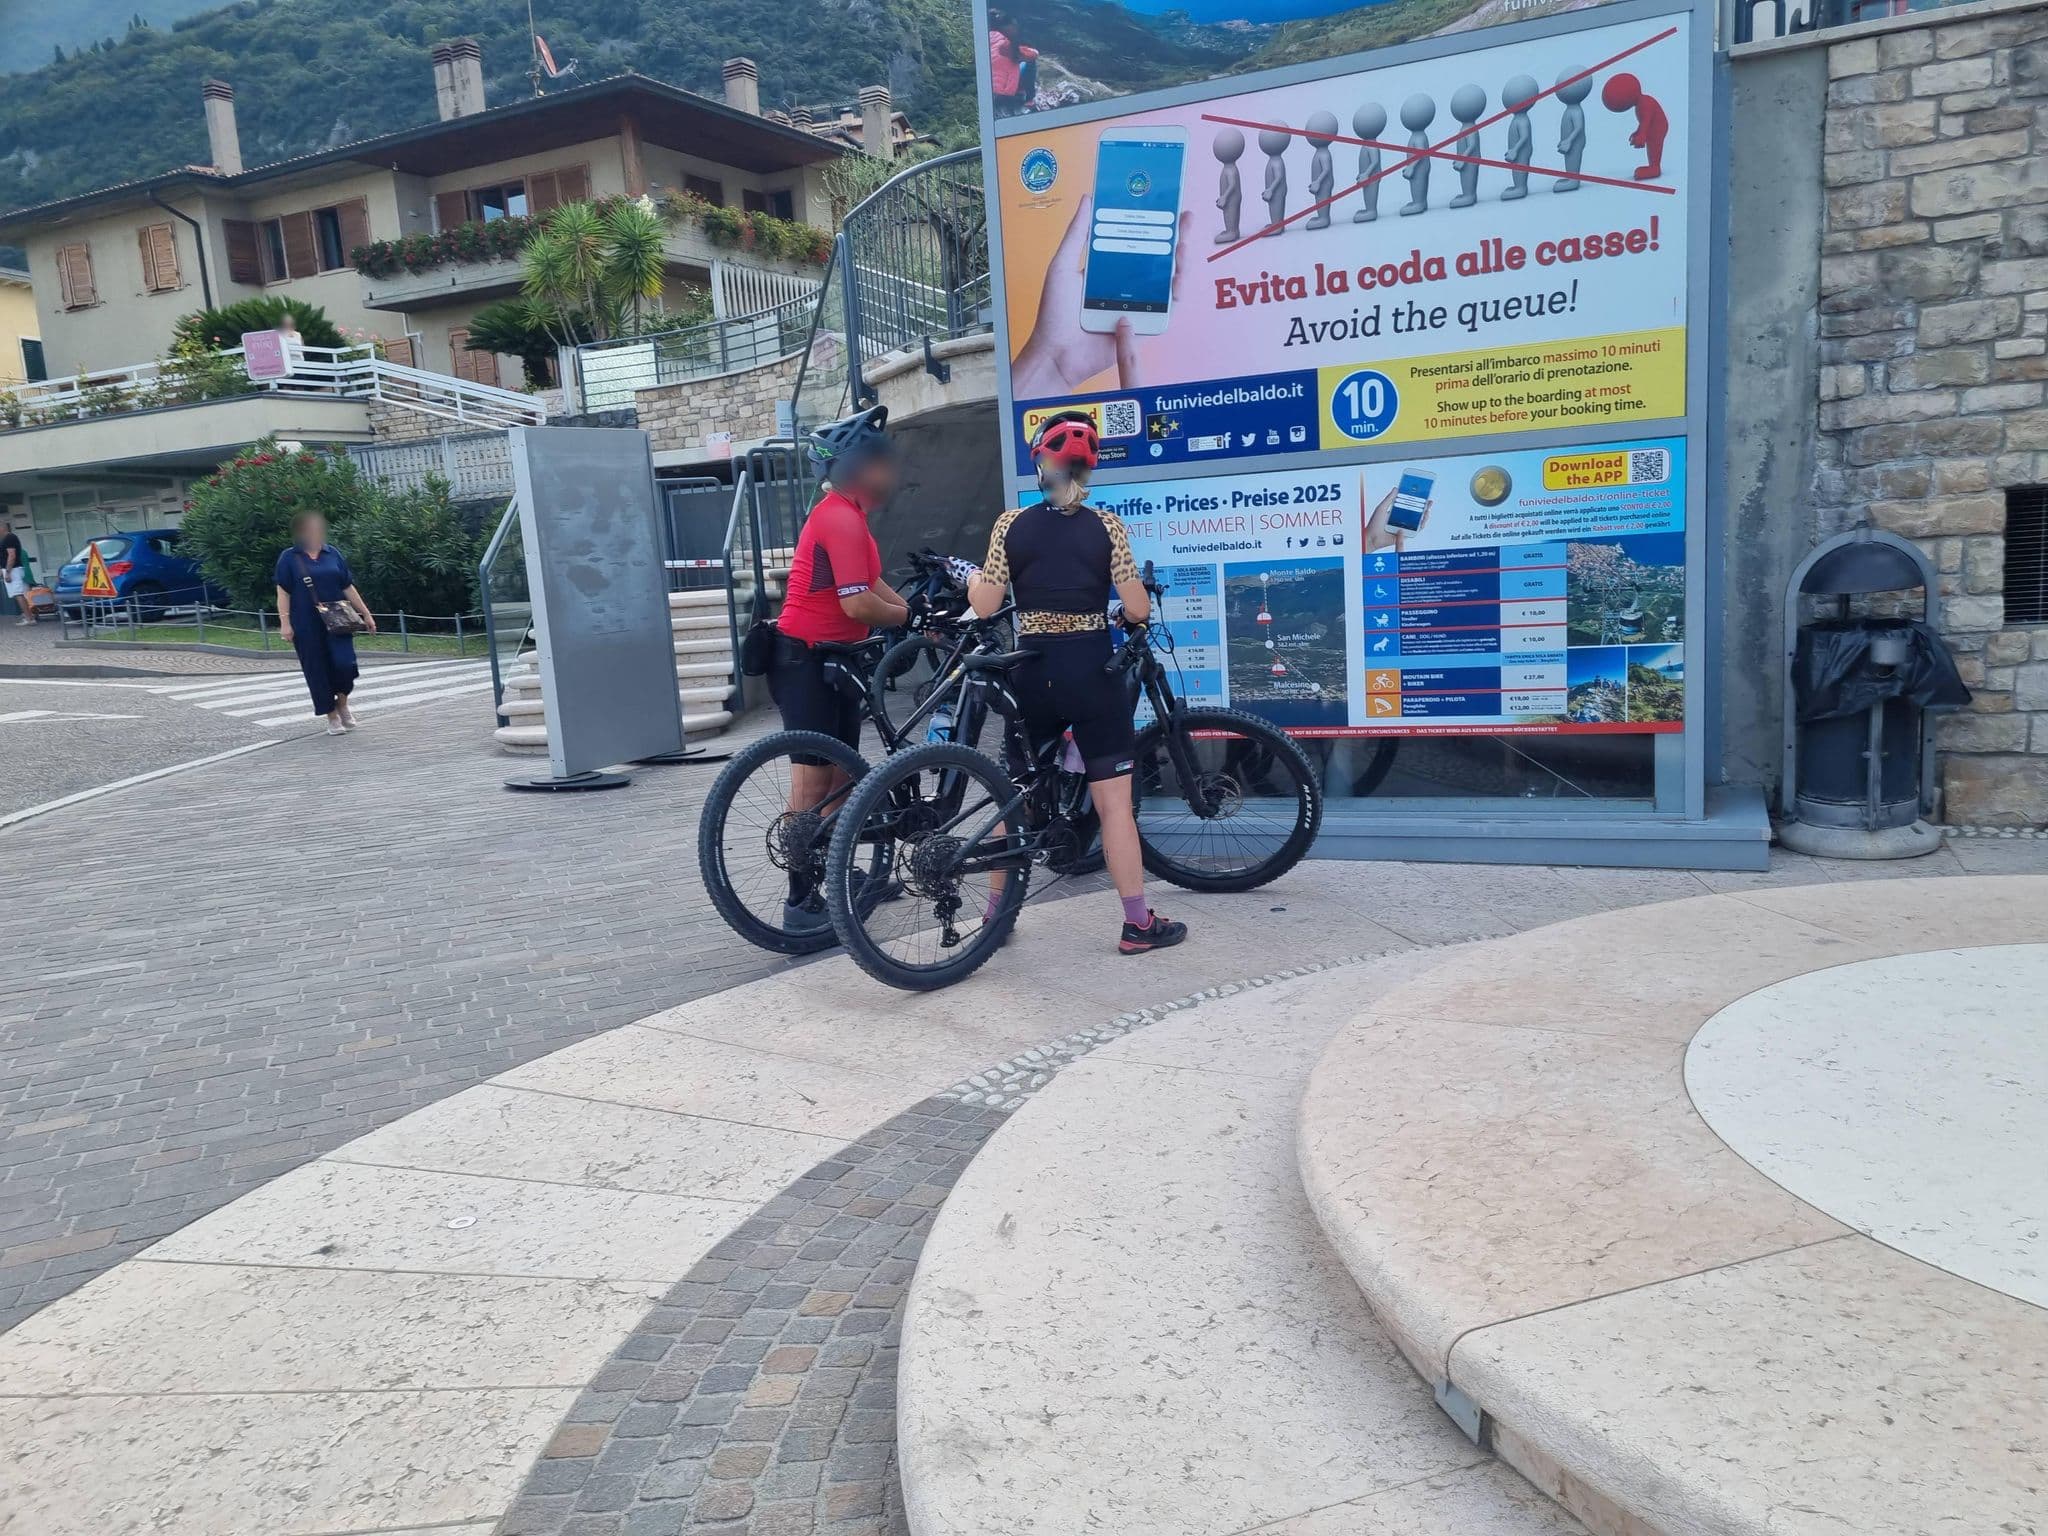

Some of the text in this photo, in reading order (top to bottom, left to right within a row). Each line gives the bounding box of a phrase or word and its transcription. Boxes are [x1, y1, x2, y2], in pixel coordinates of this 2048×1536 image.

[1215, 215, 1659, 309] Evita la coda alle casse!
[1284, 278, 1578, 347] Avoid the queue!
[1410, 340, 1661, 378] Presentarsi all'imbarco massimo 10 minuti
[1435, 361, 1633, 393] prima dell'orario di prenotazione.
[1155, 382, 1303, 412] funiviedelbaldo.it
[1343, 378, 1385, 420] 10
[1437, 384, 1631, 412] Show up to the boarding at most
[1351, 420, 1379, 435] min.
[1424, 399, 1646, 429] 10 minutes before your booking time.
[1111, 450, 1127, 459] Store
[1549, 456, 1623, 474] Download
[1567, 470, 1623, 485] the APP
[1096, 483, 1342, 517] Tariffe Prices Preise 2025
[1519, 489, 1670, 507] funiviedelbaldo.it/online-ticket
[1580, 506, 1607, 514] applicato
[1126, 508, 1343, 539] ATE SUMMER SOMMER
[1560, 517, 1582, 525] applied
[1619, 513, 1650, 522] purchased
[1172, 540, 1262, 554] funiviedelbaldo.it
[1294, 568, 1316, 576] Baldo
[1292, 633, 1321, 641] Michele
[1302, 783, 1313, 830] MAXXIS
